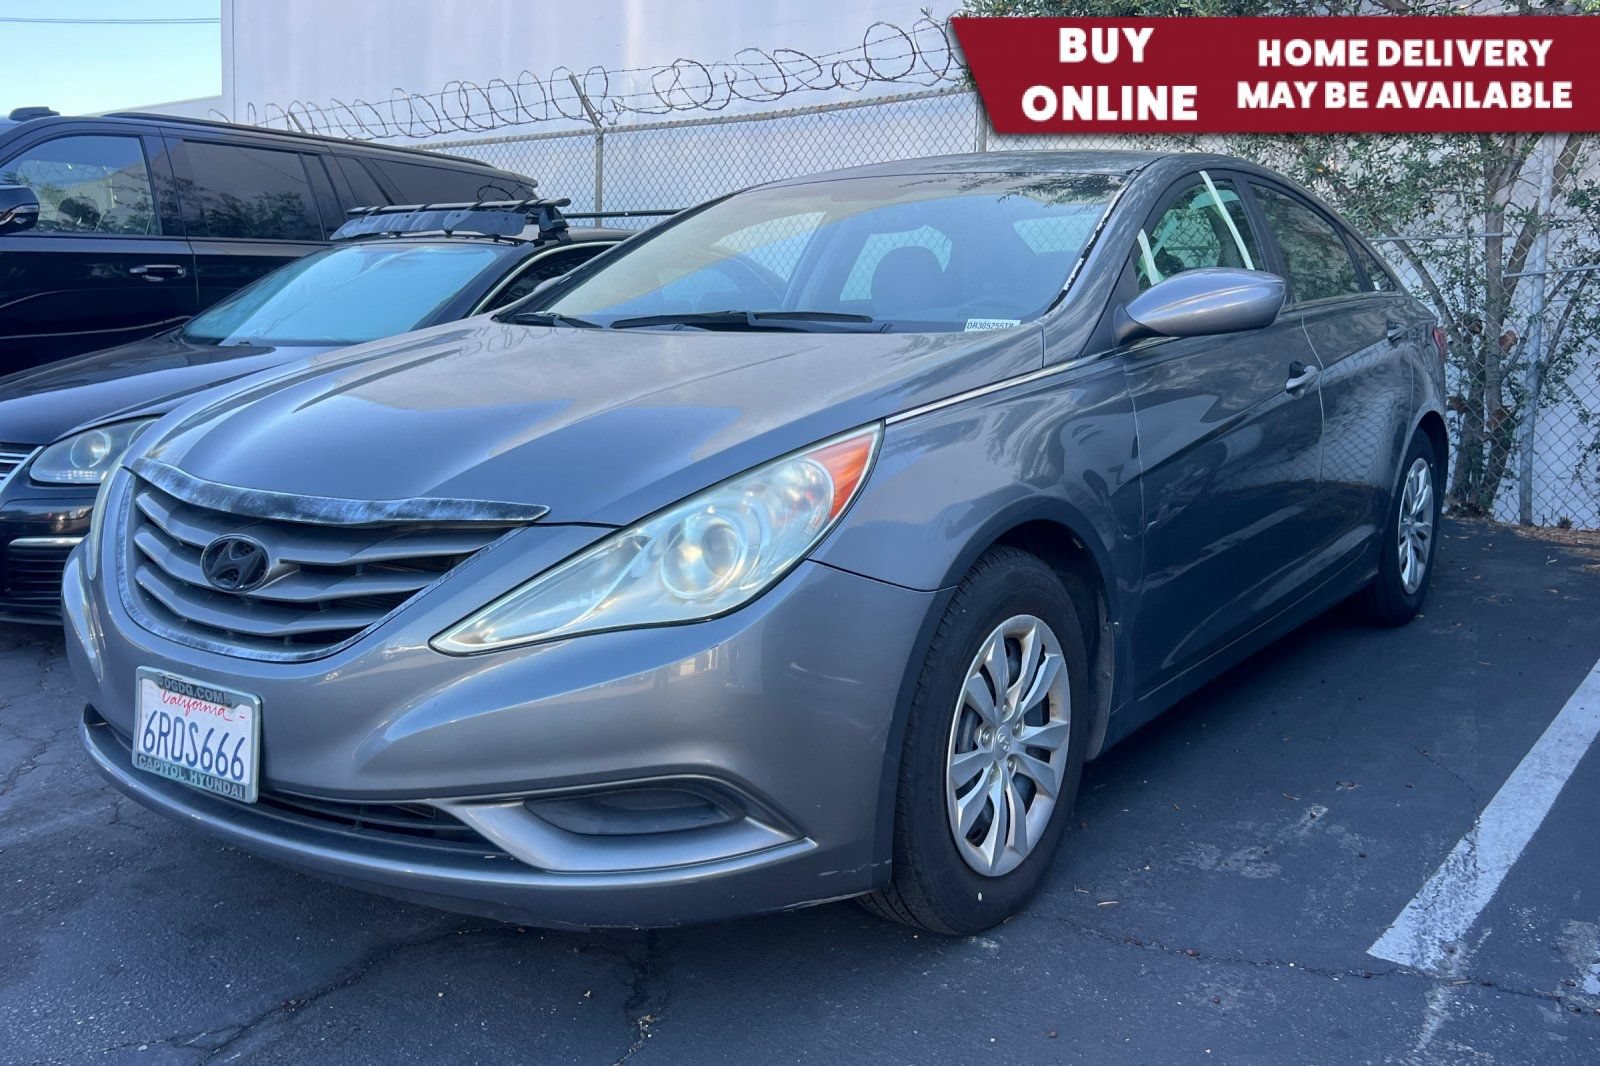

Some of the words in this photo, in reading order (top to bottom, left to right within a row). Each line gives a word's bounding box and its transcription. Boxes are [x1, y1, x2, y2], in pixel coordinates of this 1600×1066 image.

[162, 690, 233, 721] California
[138, 755, 186, 779] CAPITOL
[189, 773, 244, 799] HYUNDAI
